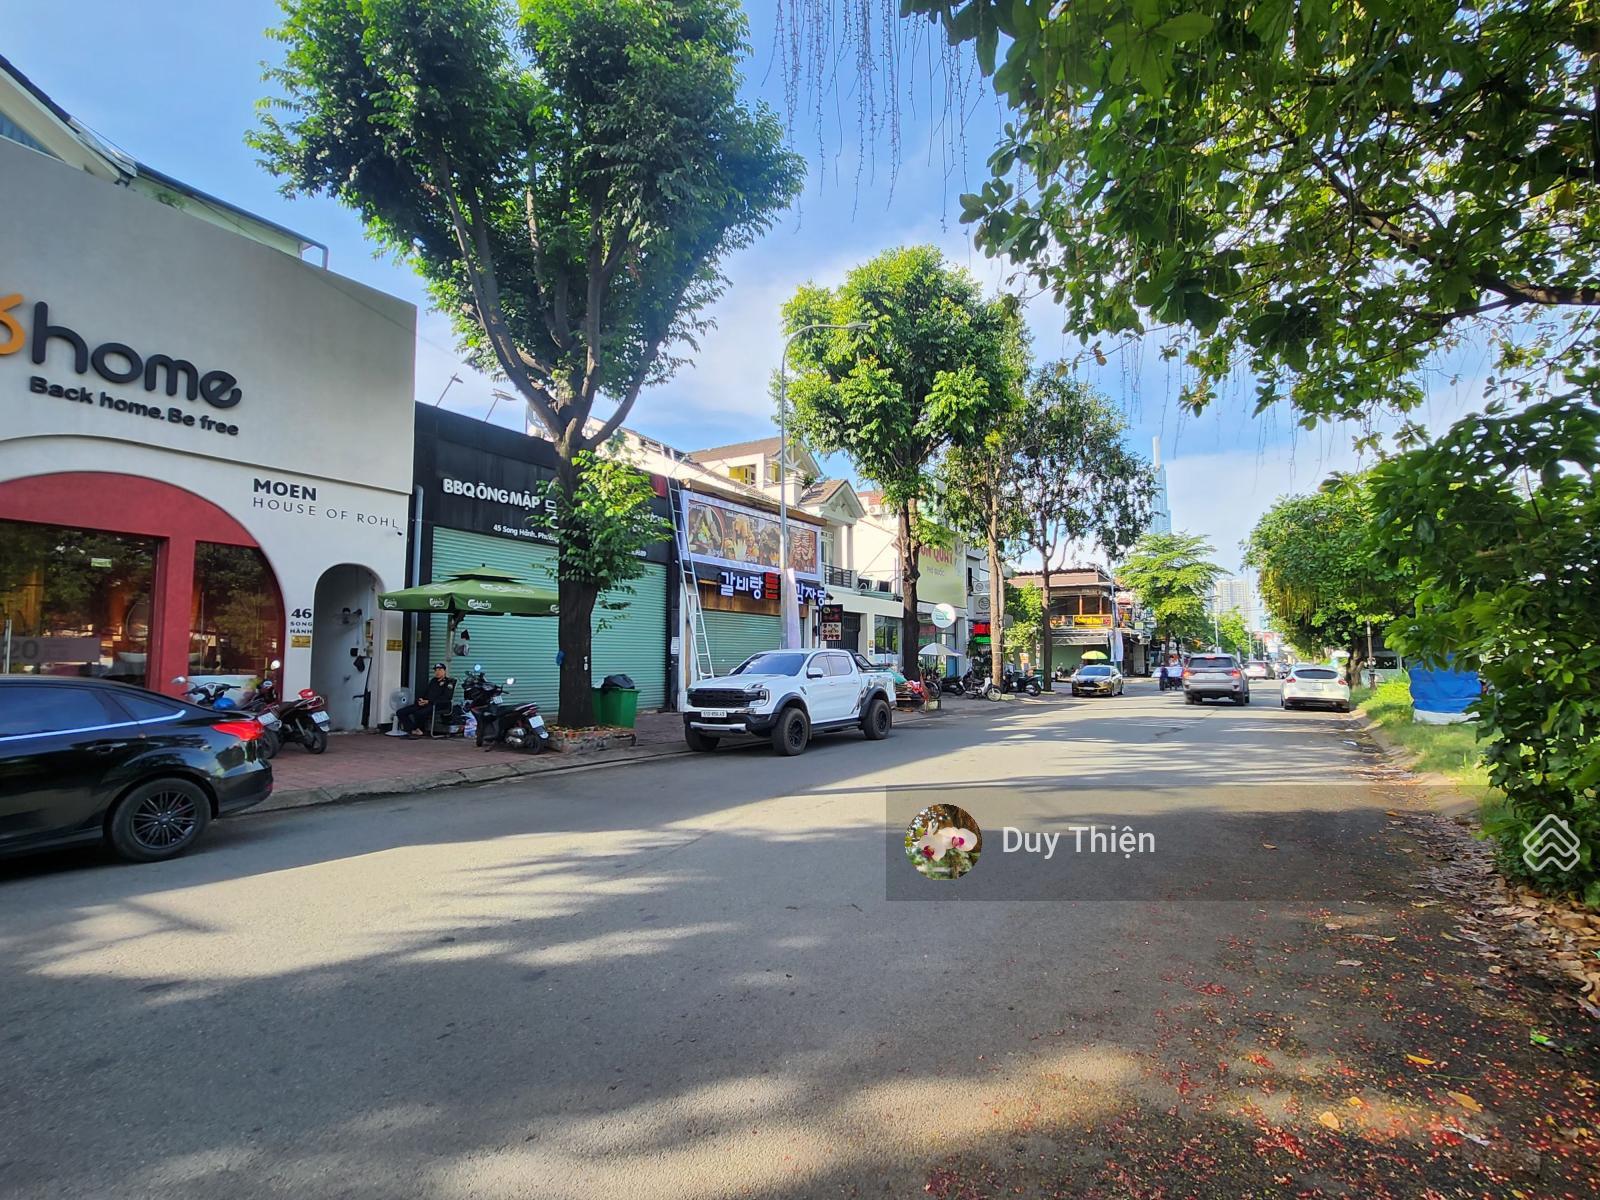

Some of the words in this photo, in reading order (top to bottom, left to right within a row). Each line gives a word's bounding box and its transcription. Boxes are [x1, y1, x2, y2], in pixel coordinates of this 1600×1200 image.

[29, 376, 94, 404] Back
[199, 415, 239, 436] free
[253, 478, 317, 501] MOEN
[443, 478, 475, 499] BBQ
[253, 497, 316, 516] HOUSE
[326, 508, 349, 520] OF
[357, 513, 399, 528] ROHL
[493, 524, 502, 532] 45
[503, 526, 518, 536] Song
[720, 571, 763, 600] 갈비탕
[291, 608, 312, 619] 46
